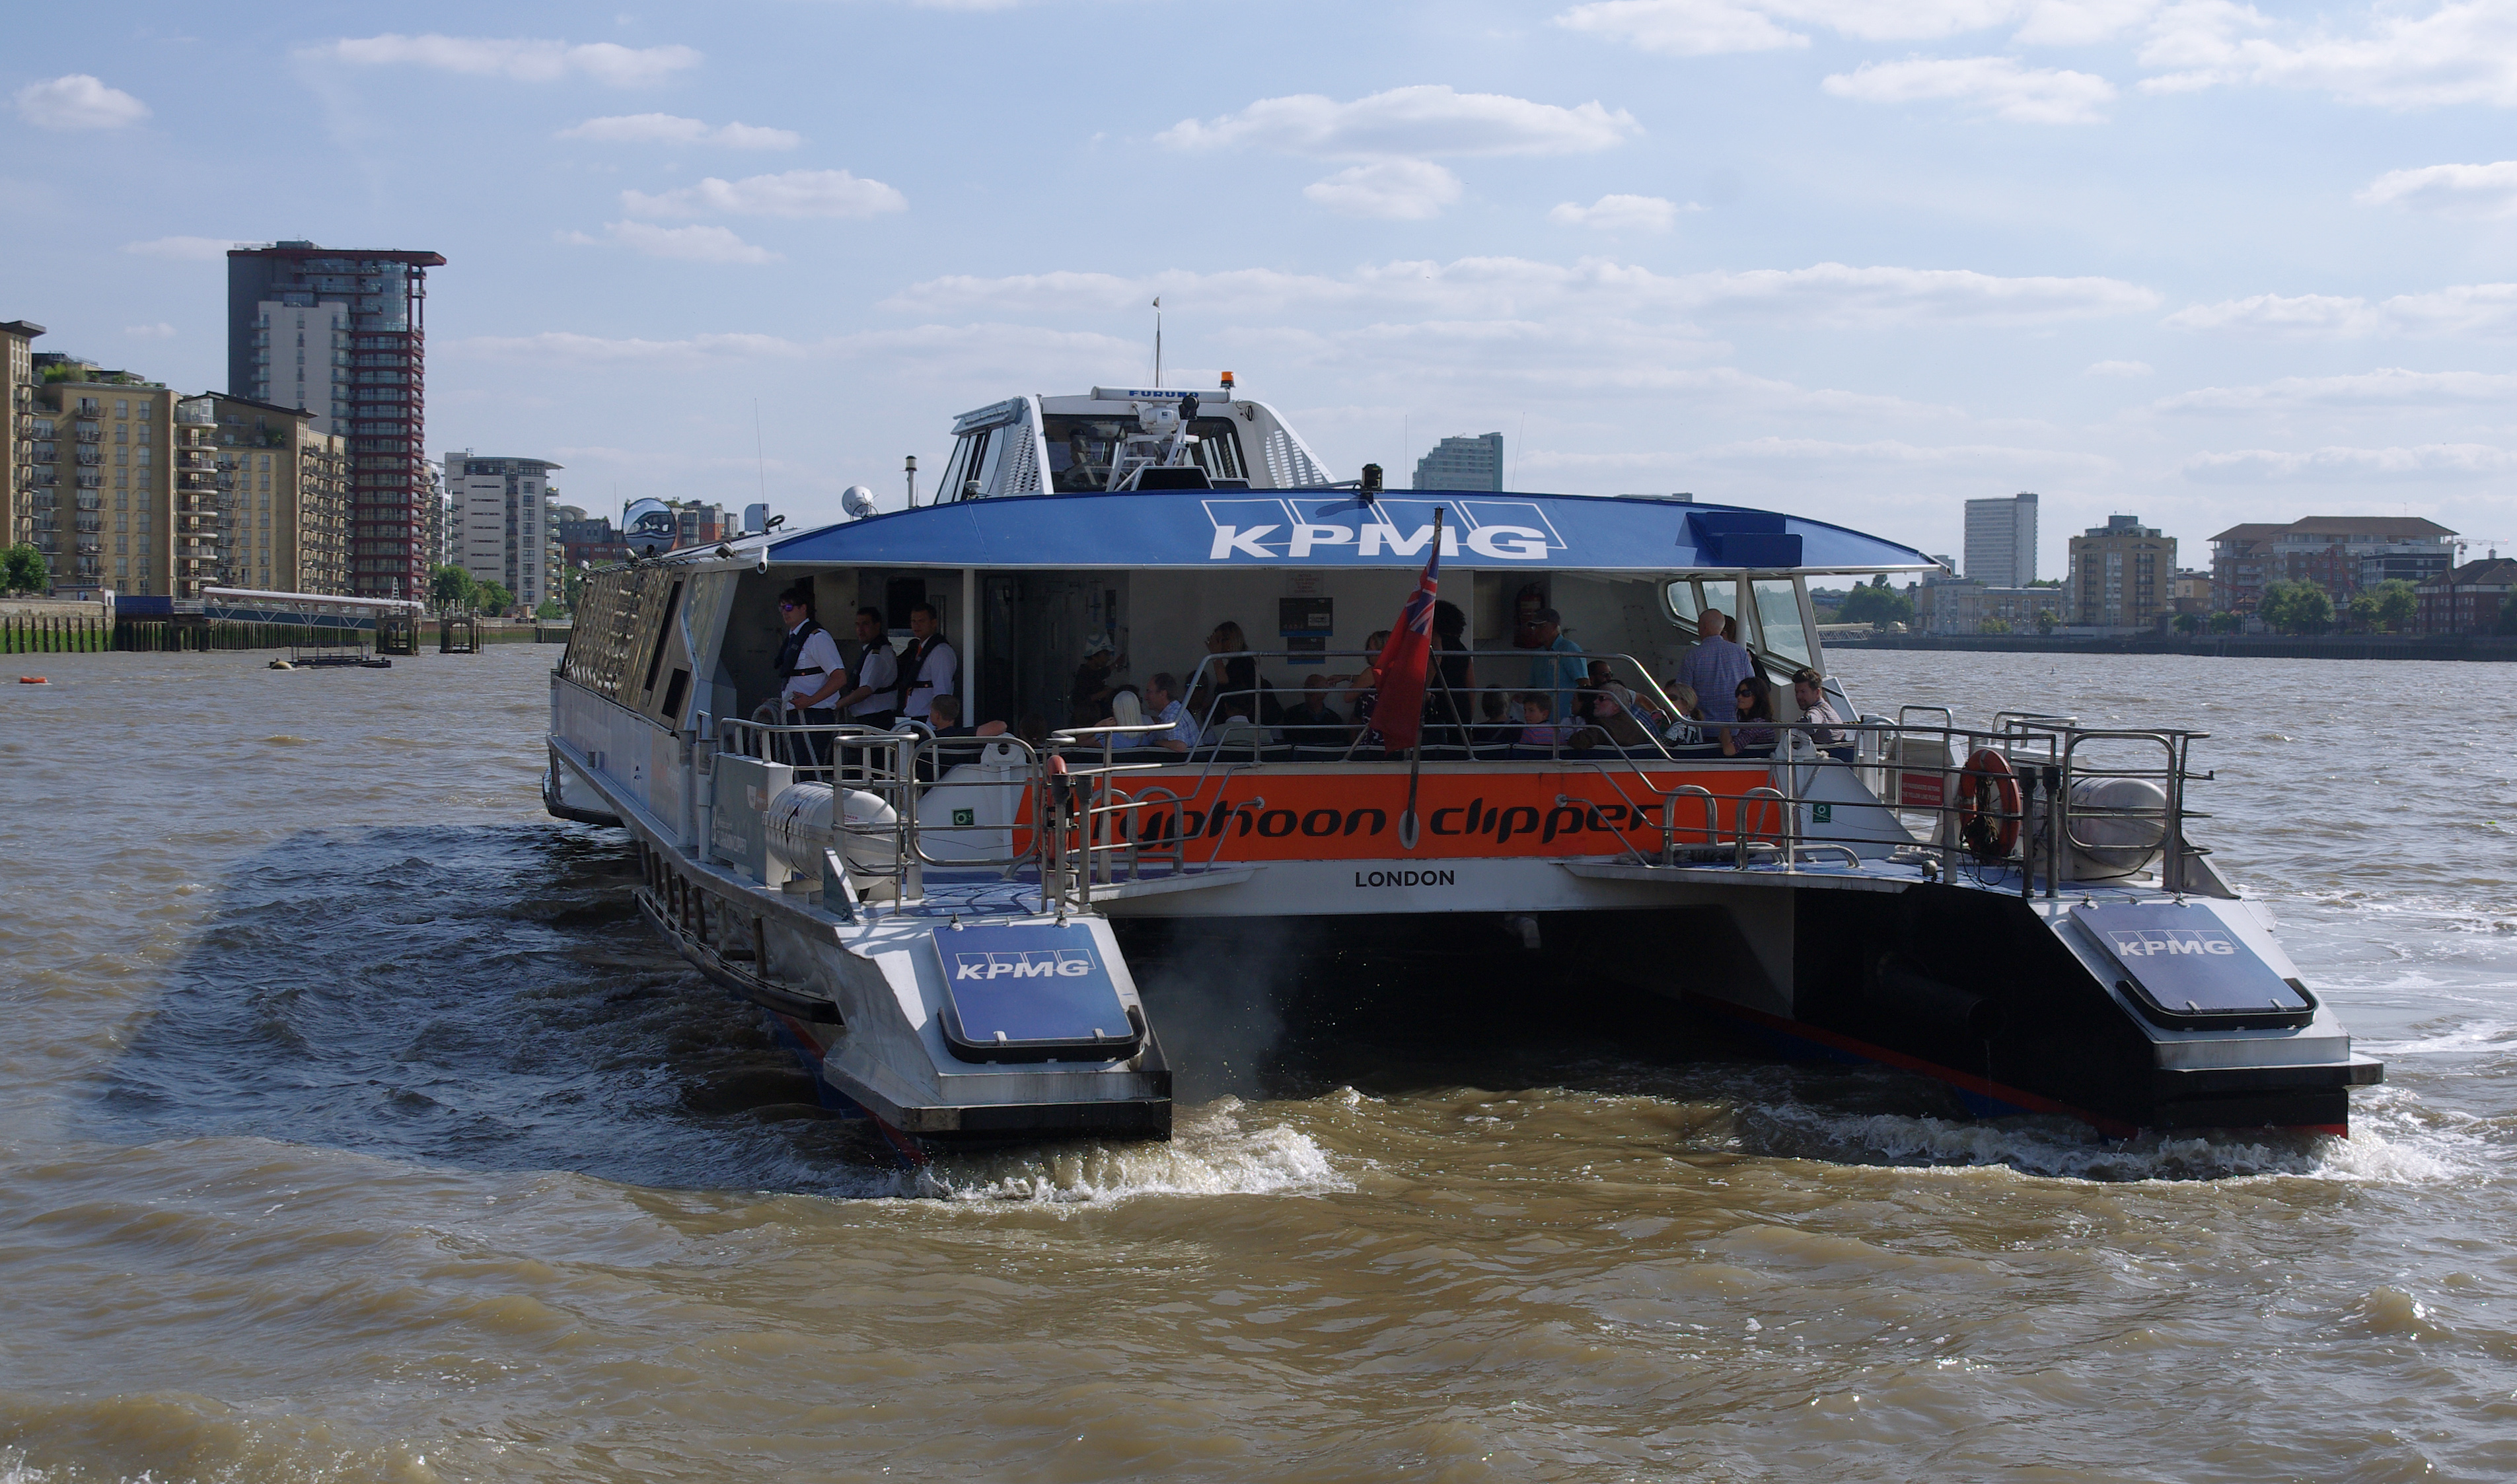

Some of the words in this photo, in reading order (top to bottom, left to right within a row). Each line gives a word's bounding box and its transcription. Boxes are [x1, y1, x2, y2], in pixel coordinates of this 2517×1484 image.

[1210, 524, 1548, 559] KPMG
[1430, 798, 1663, 844] clipper
[1356, 870, 1454, 887] LONDON
[2118, 940, 2234, 956] KPMG
[957, 960, 1089, 979] KPMG
